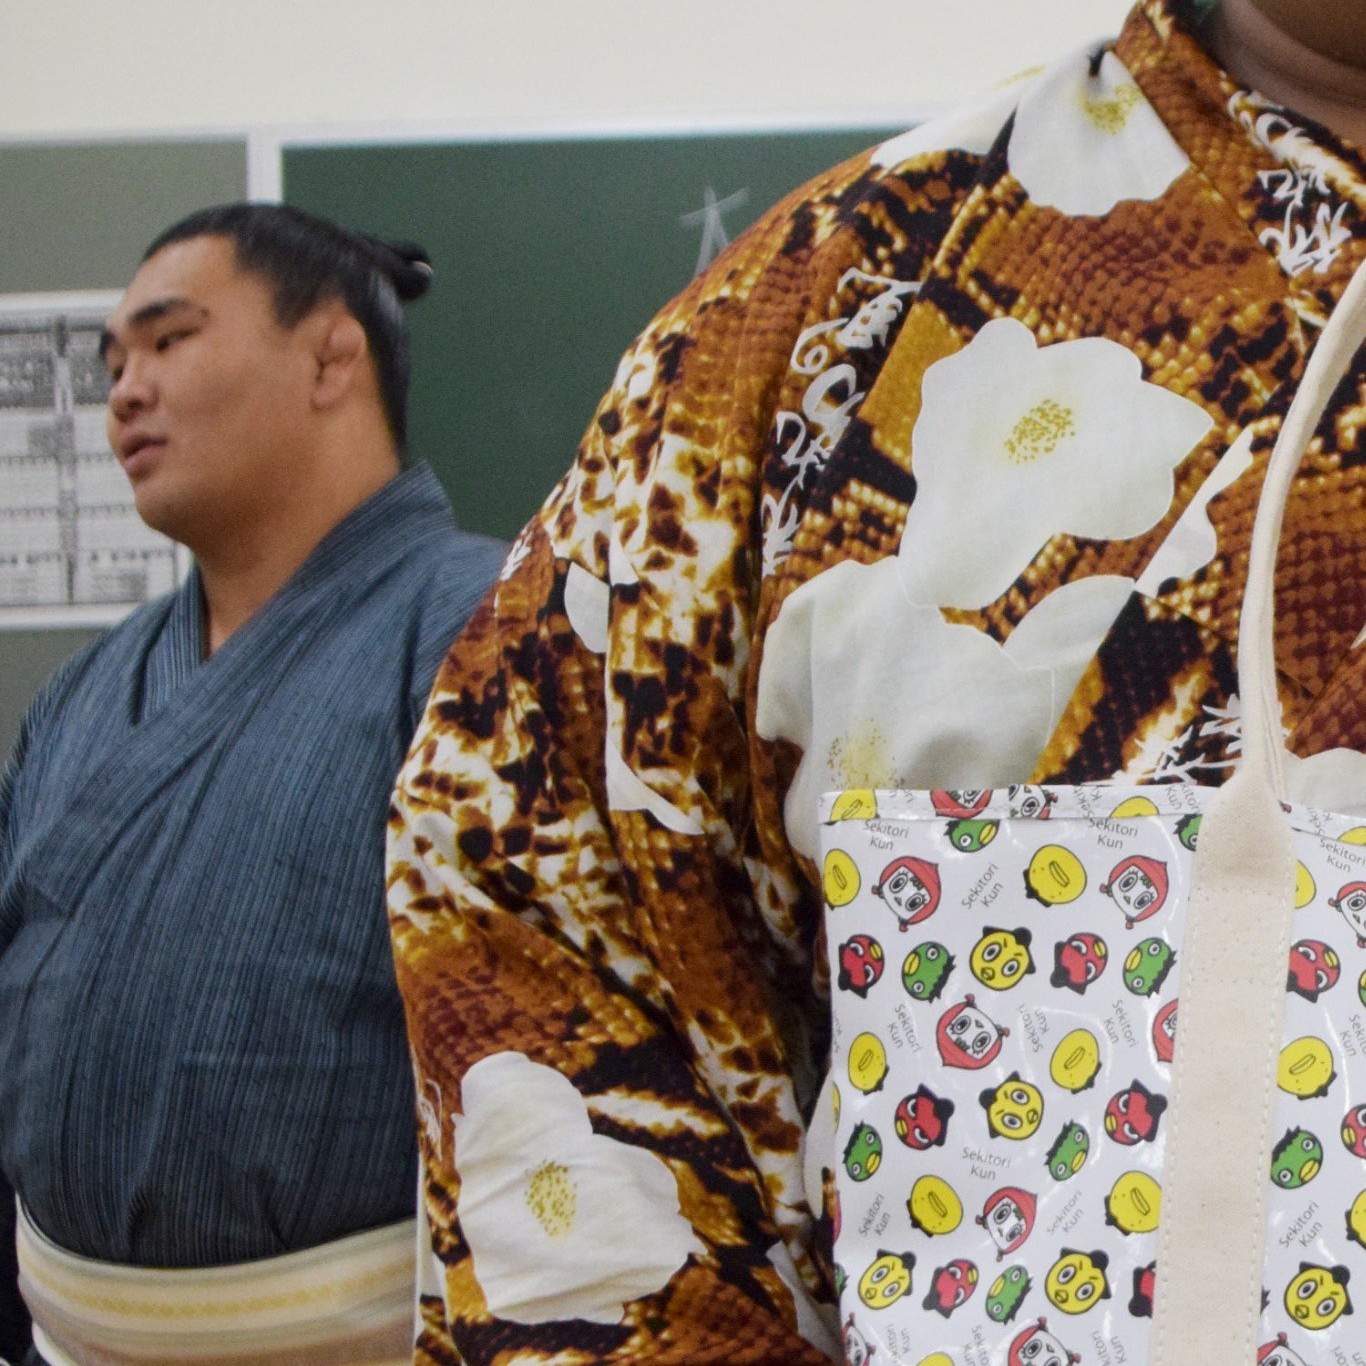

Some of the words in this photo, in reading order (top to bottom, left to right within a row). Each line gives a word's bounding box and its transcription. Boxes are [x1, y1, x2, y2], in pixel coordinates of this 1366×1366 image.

[864, 820, 910, 839] Sekitori
[1087, 817, 1139, 838] Sekitori
[870, 835, 894, 851] Kun
[1097, 835, 1124, 850] Kun
[1318, 837, 1366, 866] Sekitori
[1326, 854, 1352, 873] Kun
[961, 862, 1000, 909] Sekitori
[982, 883, 1004, 907] Kun
[894, 1004, 922, 1053] Sekitori
[1018, 1004, 1044, 1053] Sekitori
[1034, 1006, 1050, 1034] Kun
[1103, 1018, 1120, 1046] Kun
[1111, 999, 1138, 1049] Sekitori
[887, 1021, 905, 1049] Kun
[1340, 1029, 1357, 1057] Kun
[962, 1147, 1013, 1168] Sekitori
[970, 1165, 997, 1180] Kun
[858, 1193, 886, 1238] Sekitori
[875, 1211, 892, 1237] Kun
[1046, 1190, 1083, 1235] Sekitori
[1061, 1207, 1085, 1233] Kun
[1278, 1201, 1320, 1249] Sekitori
[1299, 1221, 1323, 1248] Kun
[1108, 1335, 1129, 1364] Kun
